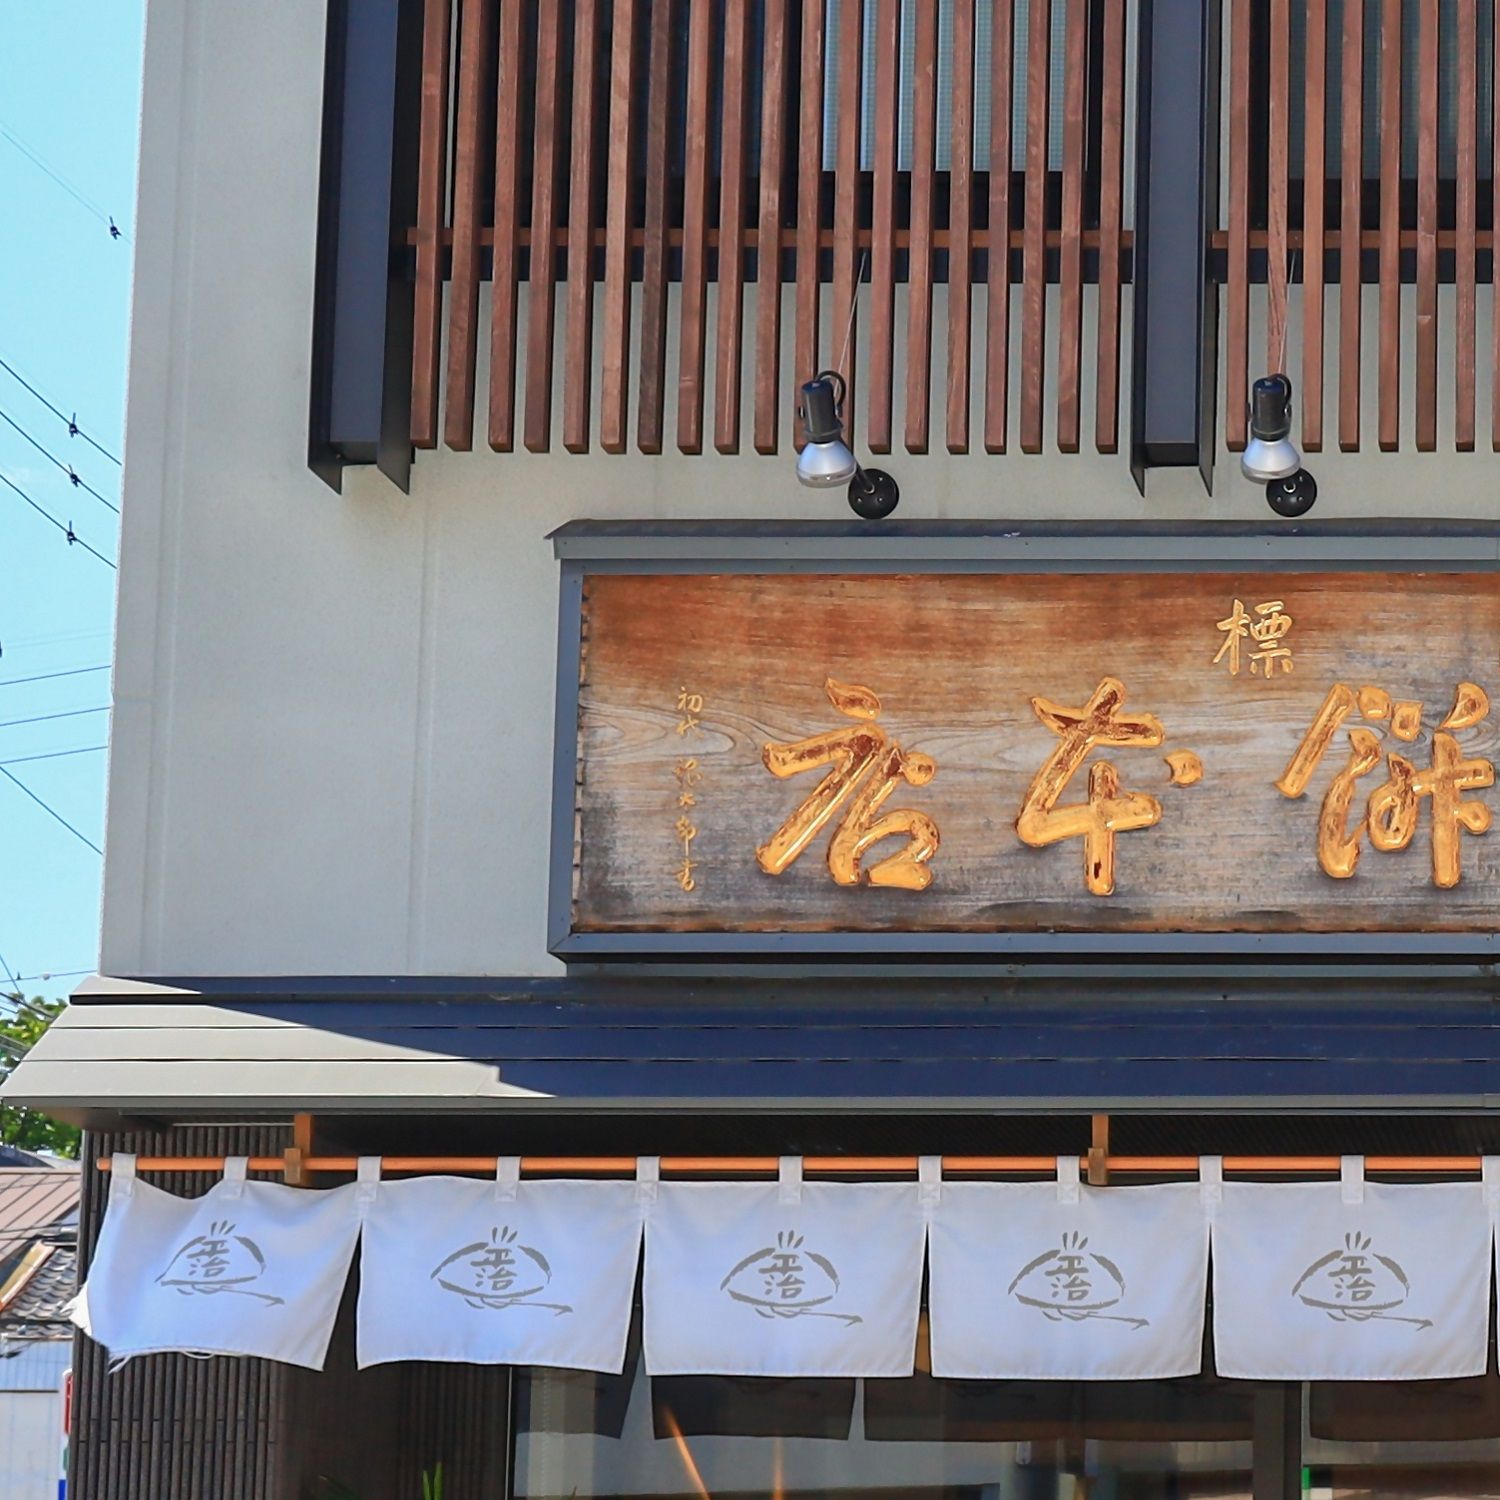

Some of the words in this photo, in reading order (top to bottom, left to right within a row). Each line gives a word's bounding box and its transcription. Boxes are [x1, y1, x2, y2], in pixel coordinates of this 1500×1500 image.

[186, 1239, 230, 1279] 平治
[470, 1248, 518, 1292] 平治
[758, 1253, 804, 1299] 平治
[1043, 1253, 1093, 1301] 平治
[1327, 1254, 1376, 1302] 平治
